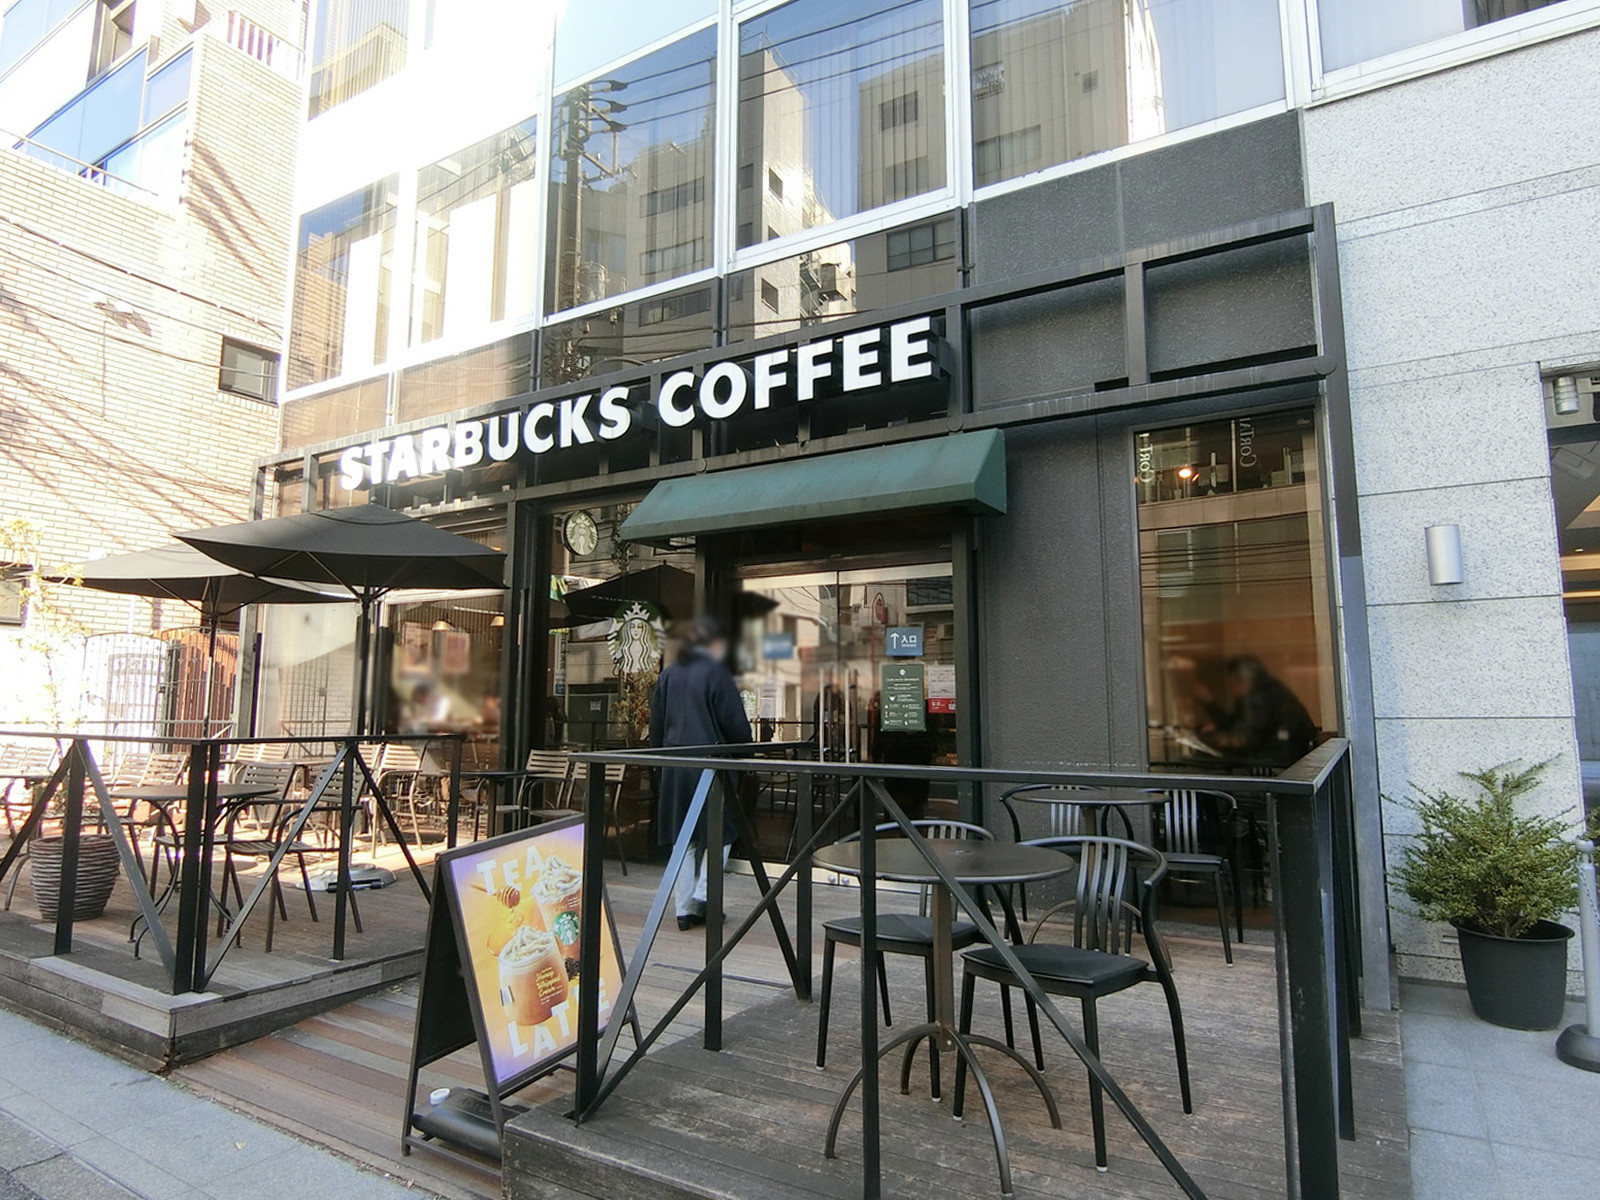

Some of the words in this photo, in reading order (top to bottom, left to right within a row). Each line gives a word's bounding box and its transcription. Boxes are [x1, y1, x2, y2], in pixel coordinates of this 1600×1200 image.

[340, 386, 631, 491] STARBUCKS
[658, 316, 932, 428] COFFEE
[901, 635, 917, 643] 入口
[476, 845, 545, 896] TEA
[507, 977, 611, 1060] LATE
